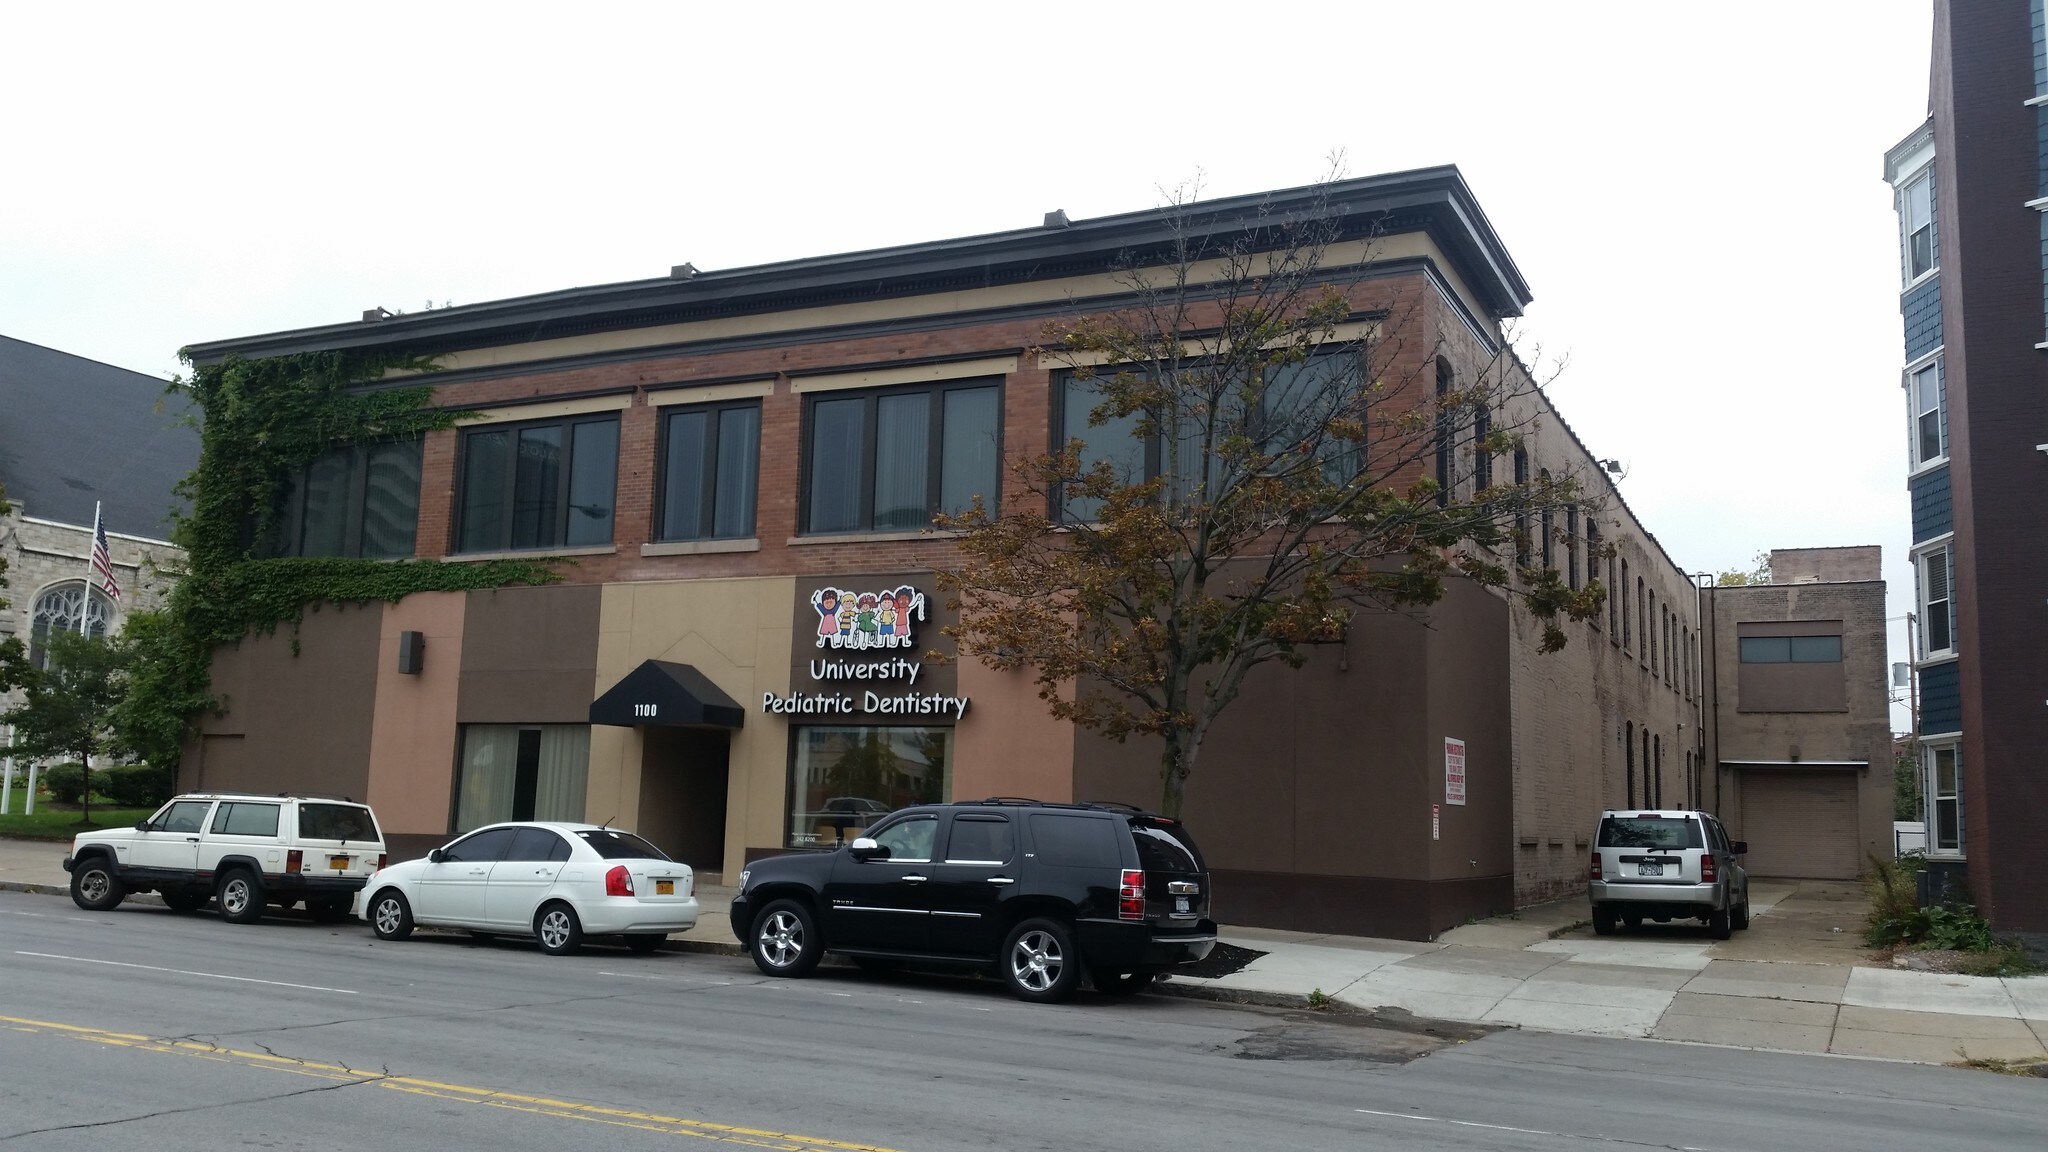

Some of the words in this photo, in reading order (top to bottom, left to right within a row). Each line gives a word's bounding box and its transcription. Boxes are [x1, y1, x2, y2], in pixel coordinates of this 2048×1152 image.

[810, 657, 920, 685] University
[634, 704, 657, 717] 1100
[762, 691, 853, 714] Pediatric
[864, 690, 968, 720] Dentistry
